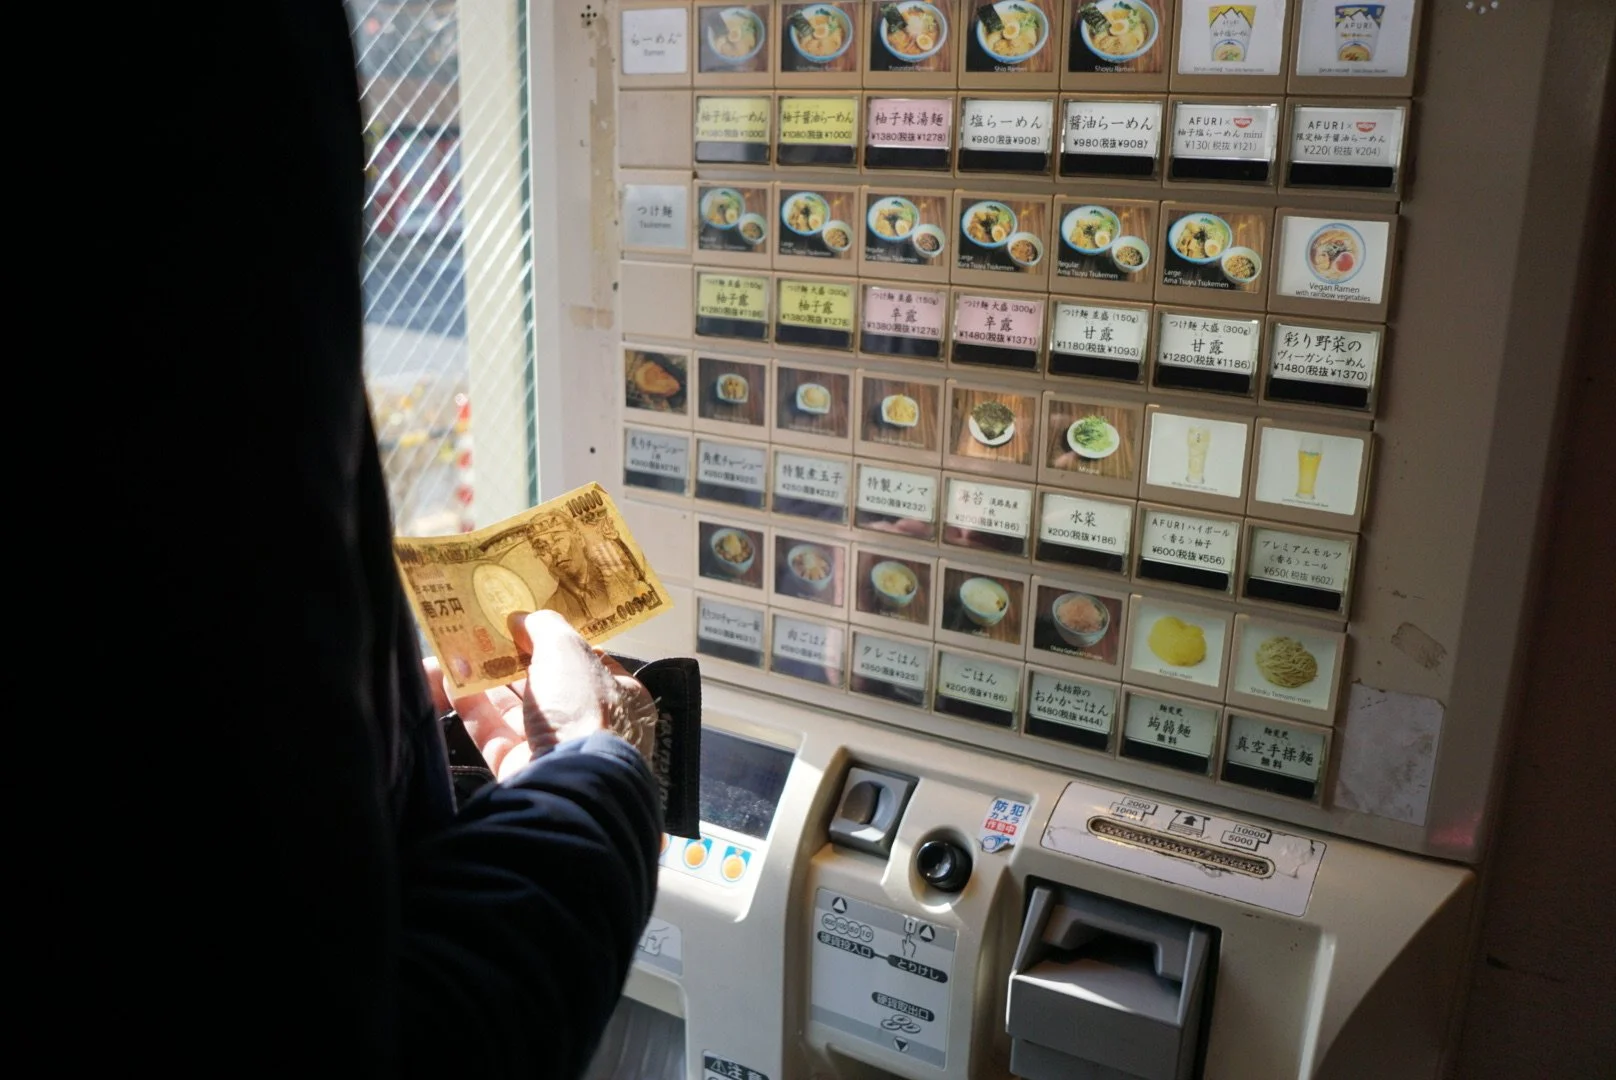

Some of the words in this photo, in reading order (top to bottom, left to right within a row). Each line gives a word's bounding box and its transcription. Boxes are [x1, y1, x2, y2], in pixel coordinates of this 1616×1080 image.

[1344, 21, 1372, 29] AFURI
[970, 114, 1042, 129] 塩らーめん
[1069, 116, 1153, 131] 醤油らーめん
[1178, 128, 1240, 138] 柚子塩らーめん
[1244, 131, 1263, 139] mini
[1296, 133, 1385, 143] 限定柚子醤油らーめん
[638, 205, 672, 218] つけ麺
[1072, 269, 1088, 277] Tsuyu
[1089, 270, 1118, 278] Tsukemen
[1179, 278, 1196, 286] Tsuyu
[1197, 279, 1229, 288] Tsukemen
[1309, 282, 1332, 291] Vegan
[1334, 285, 1360, 293] Ramen
[964, 301, 988, 309] つけ麺
[991, 302, 1008, 311] 大盛
[1011, 305, 1036, 314] (300g)
[1062, 308, 1090, 321] つけ麺
[1092, 310, 1108, 322] 並盛
[1112, 312, 1139, 323] (150g)
[984, 315, 1013, 332] 辛露
[1170, 319, 1197, 332] つけ麺
[1200, 322, 1219, 334] 大盛
[1222, 323, 1251, 335] (300g)
[1083, 326, 1113, 341] 甘露
[1191, 338, 1224, 355] 甘露
[1283, 331, 1361, 352] 彩り野菜の
[1277, 349, 1366, 369] ヴィーガンらーめん
[782, 464, 842, 485] 特製煮玉子
[867, 476, 929, 496] 特製メンマ
[565, 490, 604, 518] 10000
[1070, 510, 1096, 527] 水菜
[1262, 540, 1342, 559] プレミアムモルツ
[863, 646, 919, 667] タレごはん
[960, 667, 997, 685] ごはん
[1035, 690, 1109, 716] おかかごはん
[1147, 716, 1191, 738] 蒟蒻麺
[1157, 733, 1177, 745] 無料
[1235, 736, 1314, 766] 真空手揉麺
[1261, 756, 1282, 769] 無料
[993, 799, 1025, 817] 防犯
[1116, 806, 1138, 816] 1000
[1127, 800, 1151, 810] 2000
[989, 812, 1019, 824] カメラ
[1228, 835, 1253, 846] 5000
[1237, 827, 1266, 839] 10000
[850, 926, 859, 934] 50
[862, 930, 871, 938] 10
[820, 933, 872, 958] 硬貨投入口
[897, 959, 940, 980] とりけし
[877, 993, 930, 1019] 硬貨取出口
